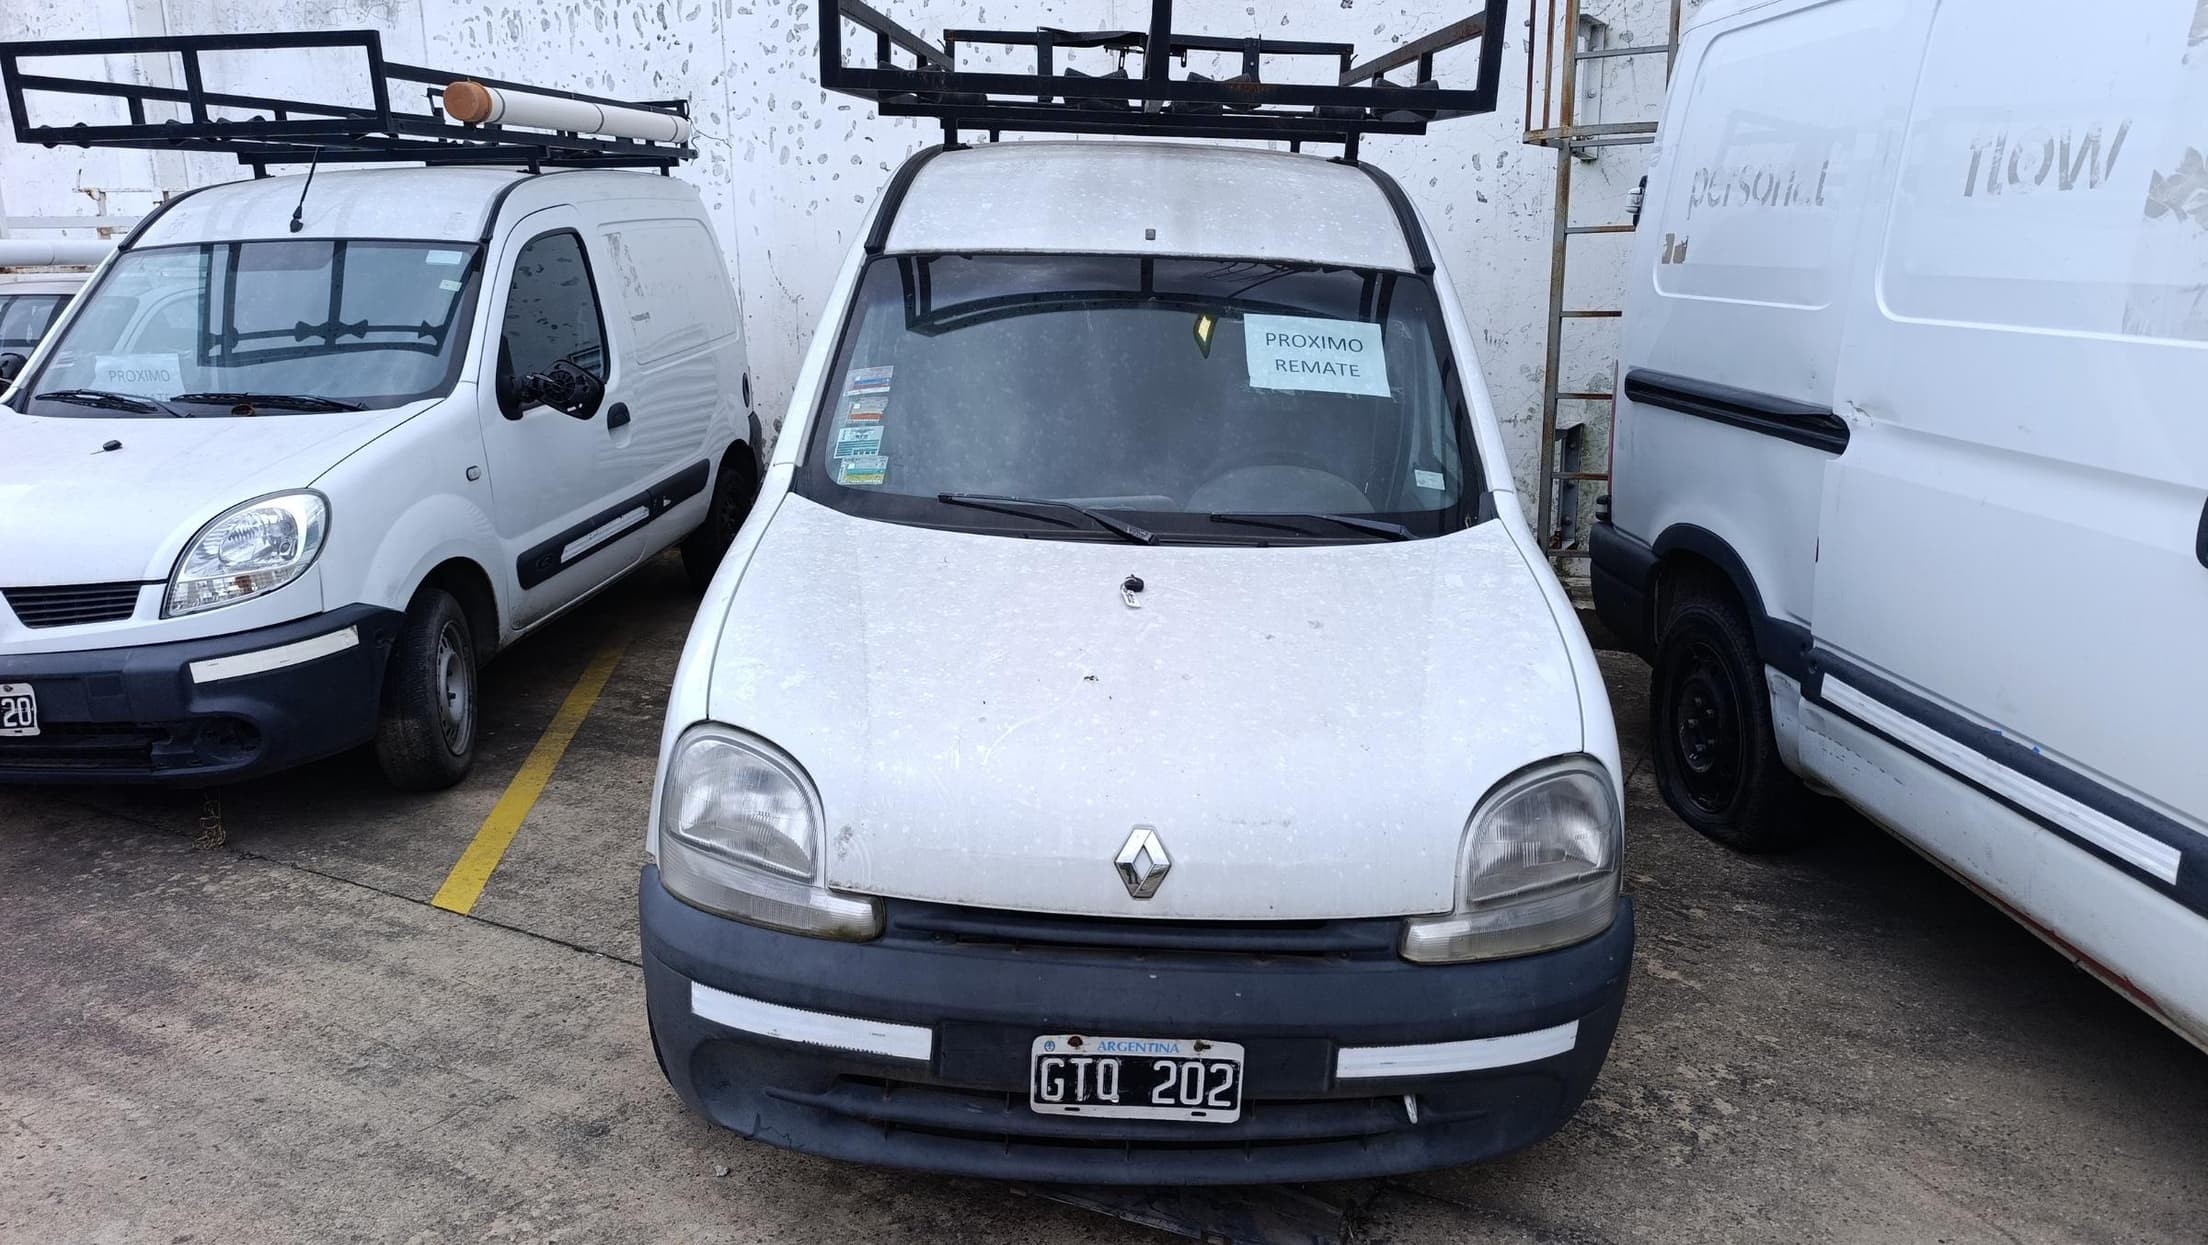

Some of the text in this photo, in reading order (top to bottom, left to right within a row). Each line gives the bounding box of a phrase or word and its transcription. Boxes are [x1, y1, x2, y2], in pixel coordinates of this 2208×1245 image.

[1265, 332, 1364, 353] PROXIMO
[108, 369, 170, 383] PROXIMO
[1274, 358, 1361, 378] REMATE
[1096, 1040, 1180, 1054] ARGENTINA
[1040, 1057, 1234, 1107] GTQ 202
